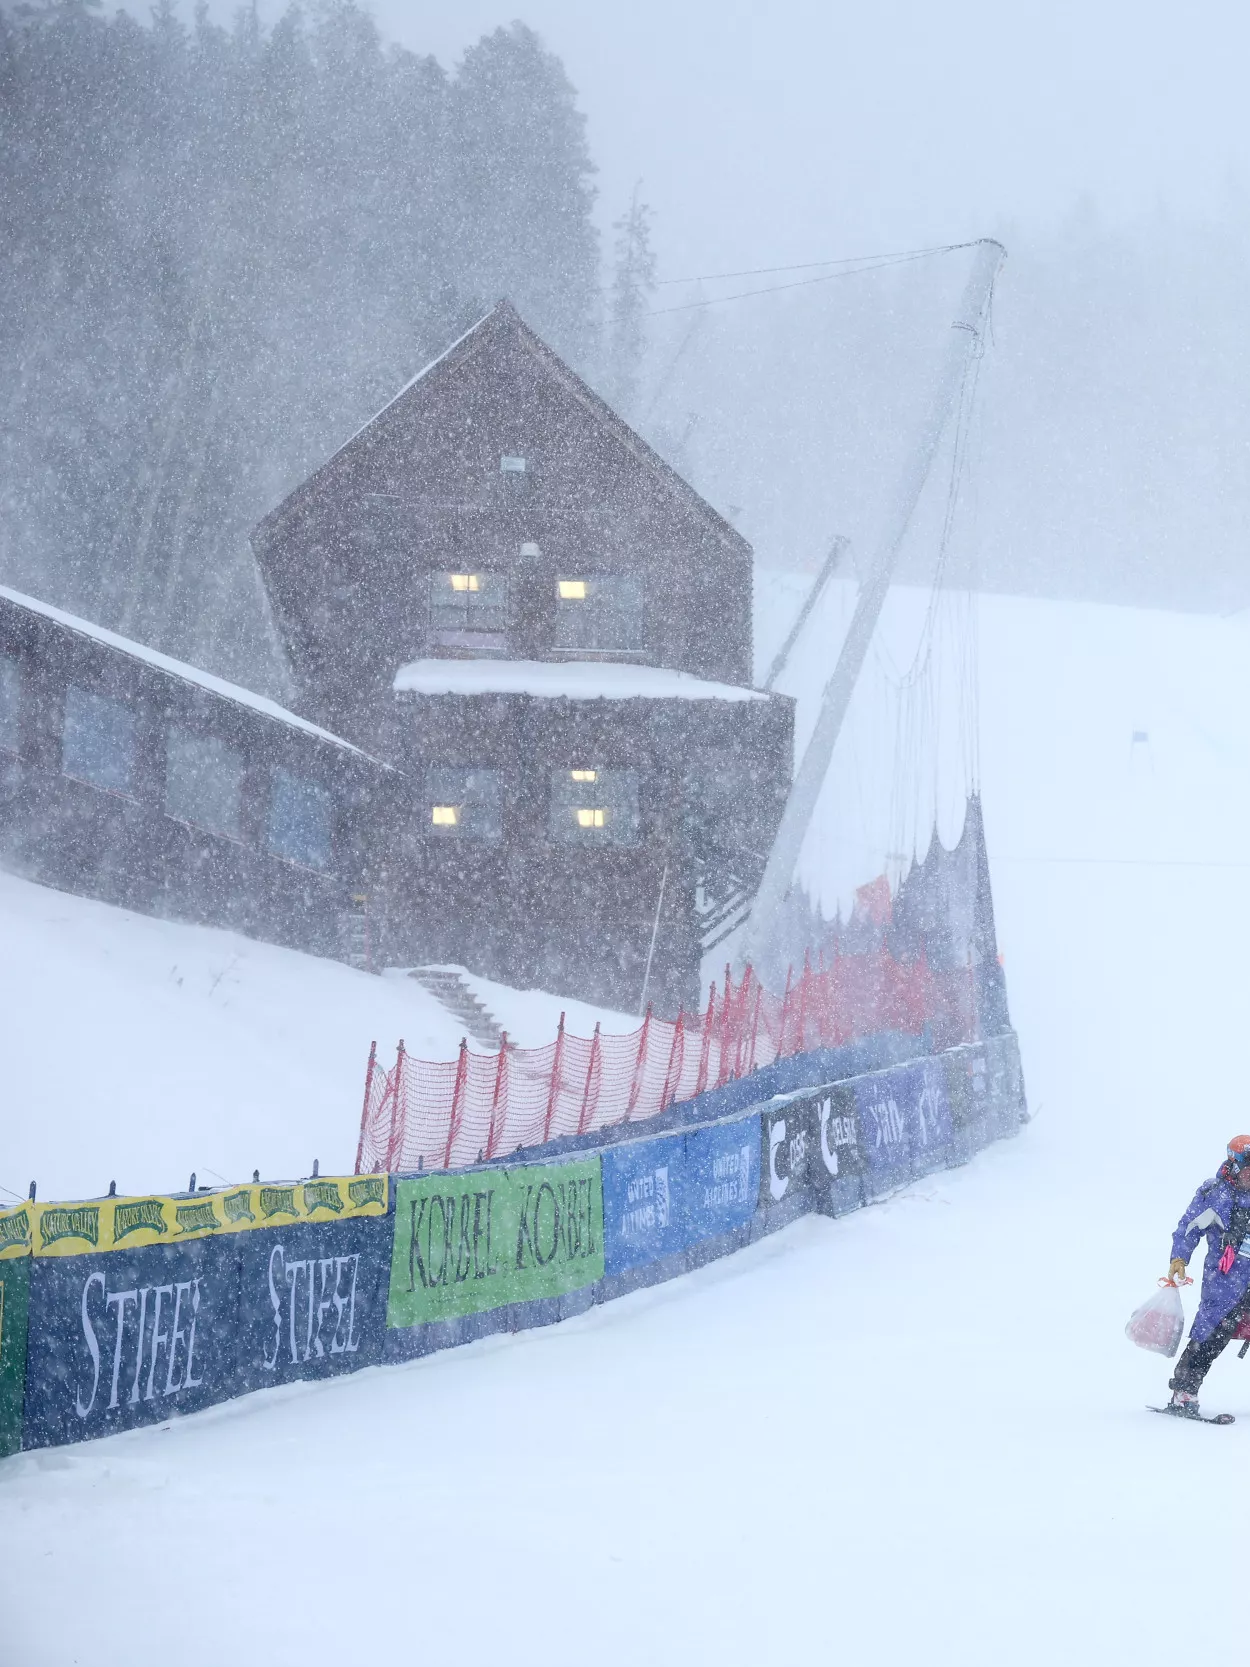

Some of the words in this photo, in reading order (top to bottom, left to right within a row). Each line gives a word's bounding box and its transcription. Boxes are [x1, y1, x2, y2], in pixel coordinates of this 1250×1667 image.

[42, 1212, 72, 1245] NATURE
[71, 1210, 98, 1243] VALLEY
[406, 1189, 497, 1293] KORBEL
[76, 1271, 202, 1418] STIFEL
